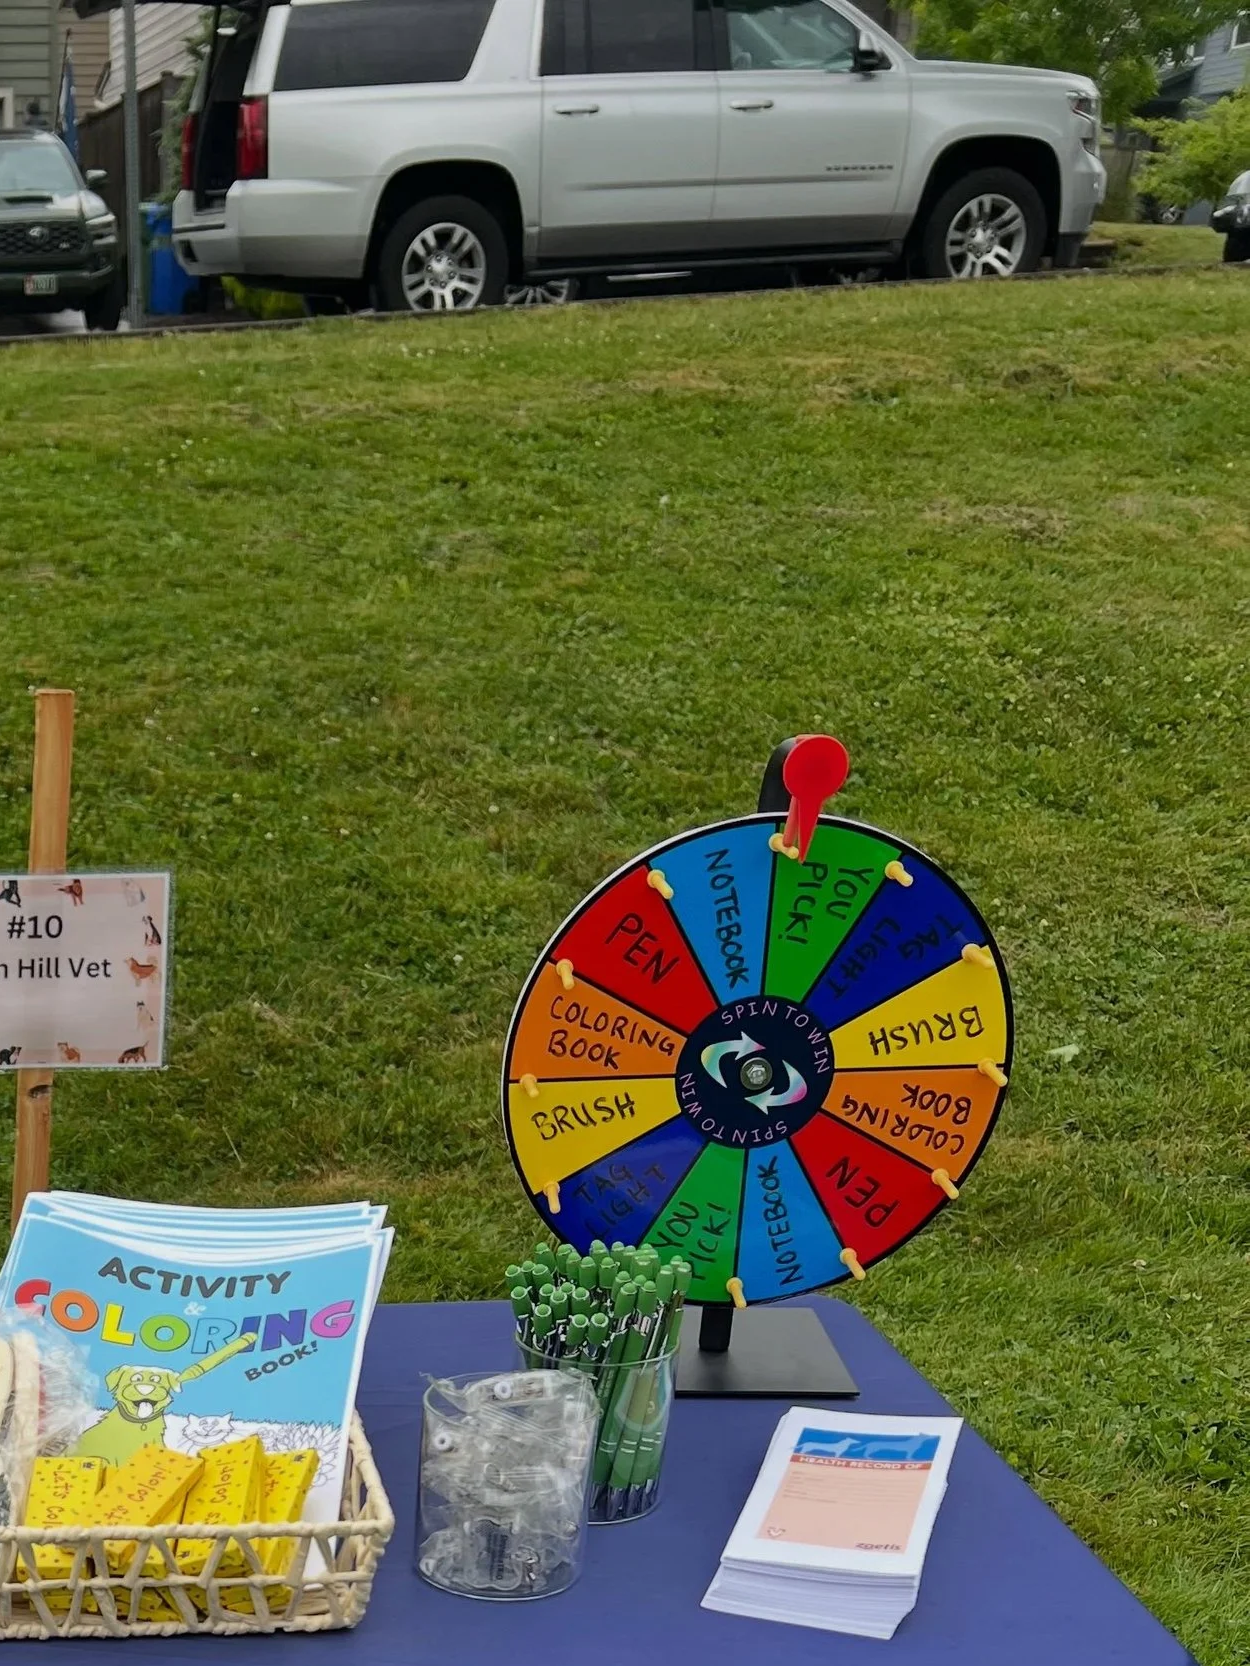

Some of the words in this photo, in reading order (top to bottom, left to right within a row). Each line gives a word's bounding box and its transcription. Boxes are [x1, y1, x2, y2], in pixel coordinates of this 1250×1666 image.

[705, 848, 750, 989] NOTEBOOK
[777, 861, 829, 945] PICK!
[825, 866, 875, 921] YOU
[6, 914, 64, 939] #10
[604, 912, 680, 985] PEN
[901, 914, 964, 962] TAG
[17, 957, 61, 979] Hill
[68, 957, 112, 978] Vet
[827, 916, 901, 999] LIGHT
[547, 1029, 621, 1070] BOOK
[550, 995, 676, 1057] COLORING
[721, 1000, 778, 1025] SPIN
[784, 1005, 809, 1028] TO
[807, 1027, 830, 1074] WIN
[867, 1005, 985, 1056] BRUSH
[530, 1091, 636, 1141] BRUSH
[679, 1072, 702, 1118] WIN
[900, 1082, 972, 1126] BOOK
[701, 1118, 725, 1140] TO
[731, 1120, 788, 1144] SPIN
[840, 1094, 965, 1156] COLORING
[572, 1163, 633, 1205] TAG
[825, 1155, 900, 1228] PEN
[649, 1200, 700, 1250] YOU
[756, 1154, 805, 1287] NOTEBOOK
[97, 1256, 292, 1299] ACTIVITY
[14, 1278, 356, 1355] COLORING
[182, 1300, 208, 1317] &
[244, 1340, 319, 1383] BOOK!
[799, 1456, 847, 1467] HEALTH
[850, 1461, 902, 1469] RECORD
